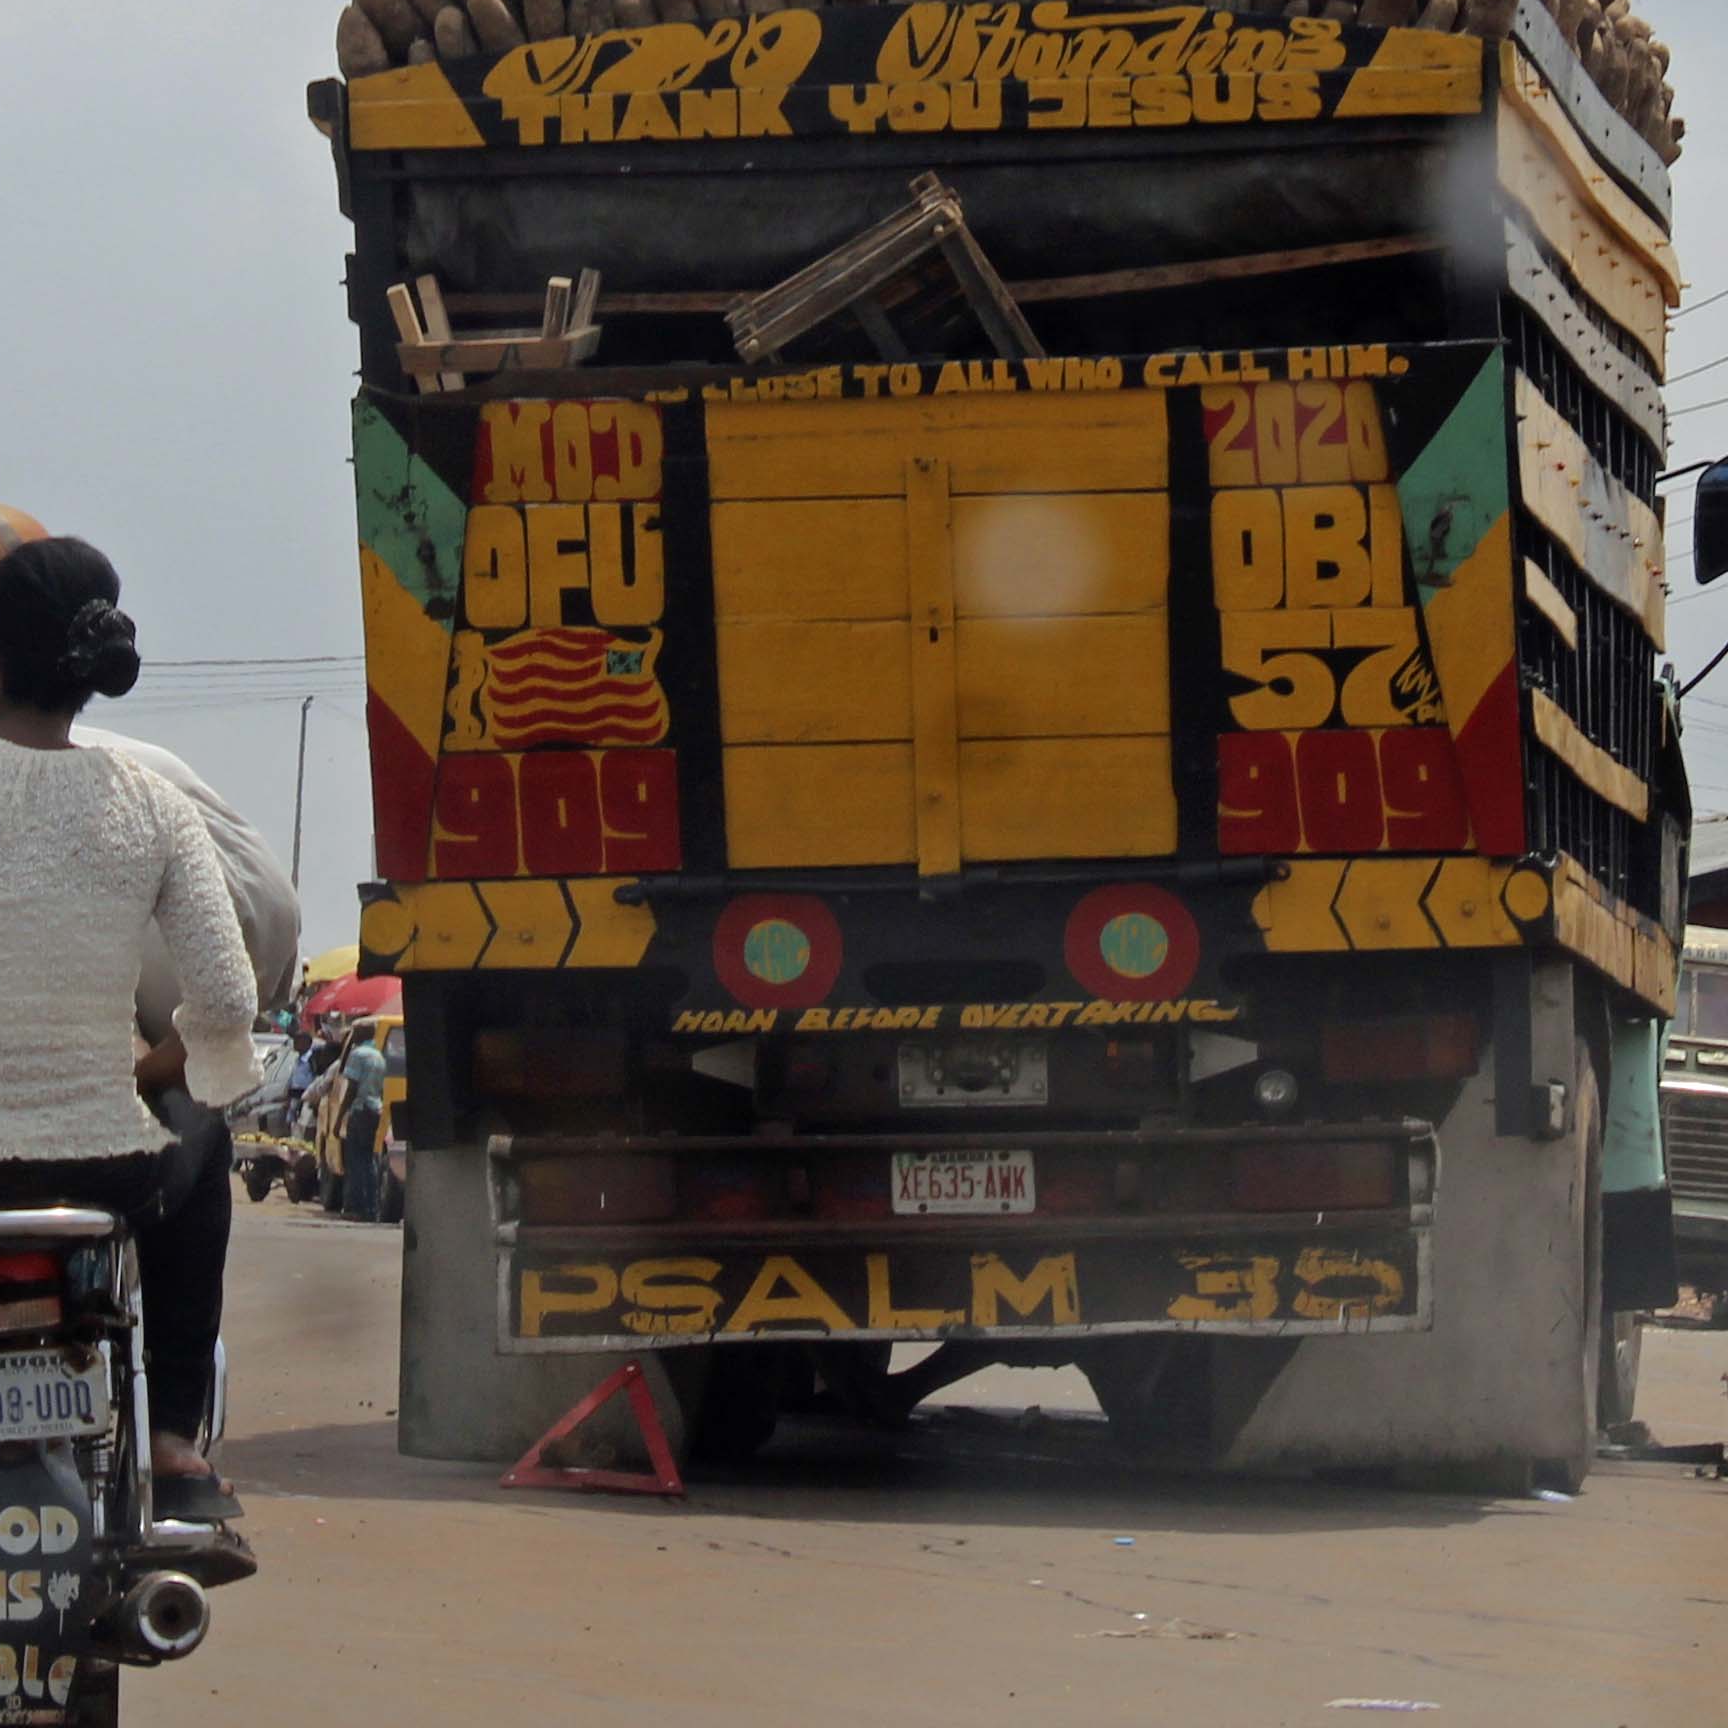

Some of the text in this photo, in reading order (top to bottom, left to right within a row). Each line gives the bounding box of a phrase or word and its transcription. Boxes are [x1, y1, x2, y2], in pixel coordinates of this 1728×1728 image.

[501, 73, 1322, 146] THANK YOU JESUS
[853, 363, 921, 398] TO
[934, 360, 1017, 395] ALL
[1024, 356, 1122, 391] WHO
[1144, 351, 1269, 387] CALL
[1201, 382, 1390, 486] 2020
[464, 503, 665, 628] OFU
[1211, 484, 1404, 609] OBI
[434, 749, 683, 878] 909
[1218, 728, 1472, 855] 909
[794, 1005, 943, 1031] BEFORE
[960, 998, 1239, 1029] OVERTAKING
[899, 1165, 1025, 1201] XE635-AWK
[519, 1251, 1081, 1337] PSALM
